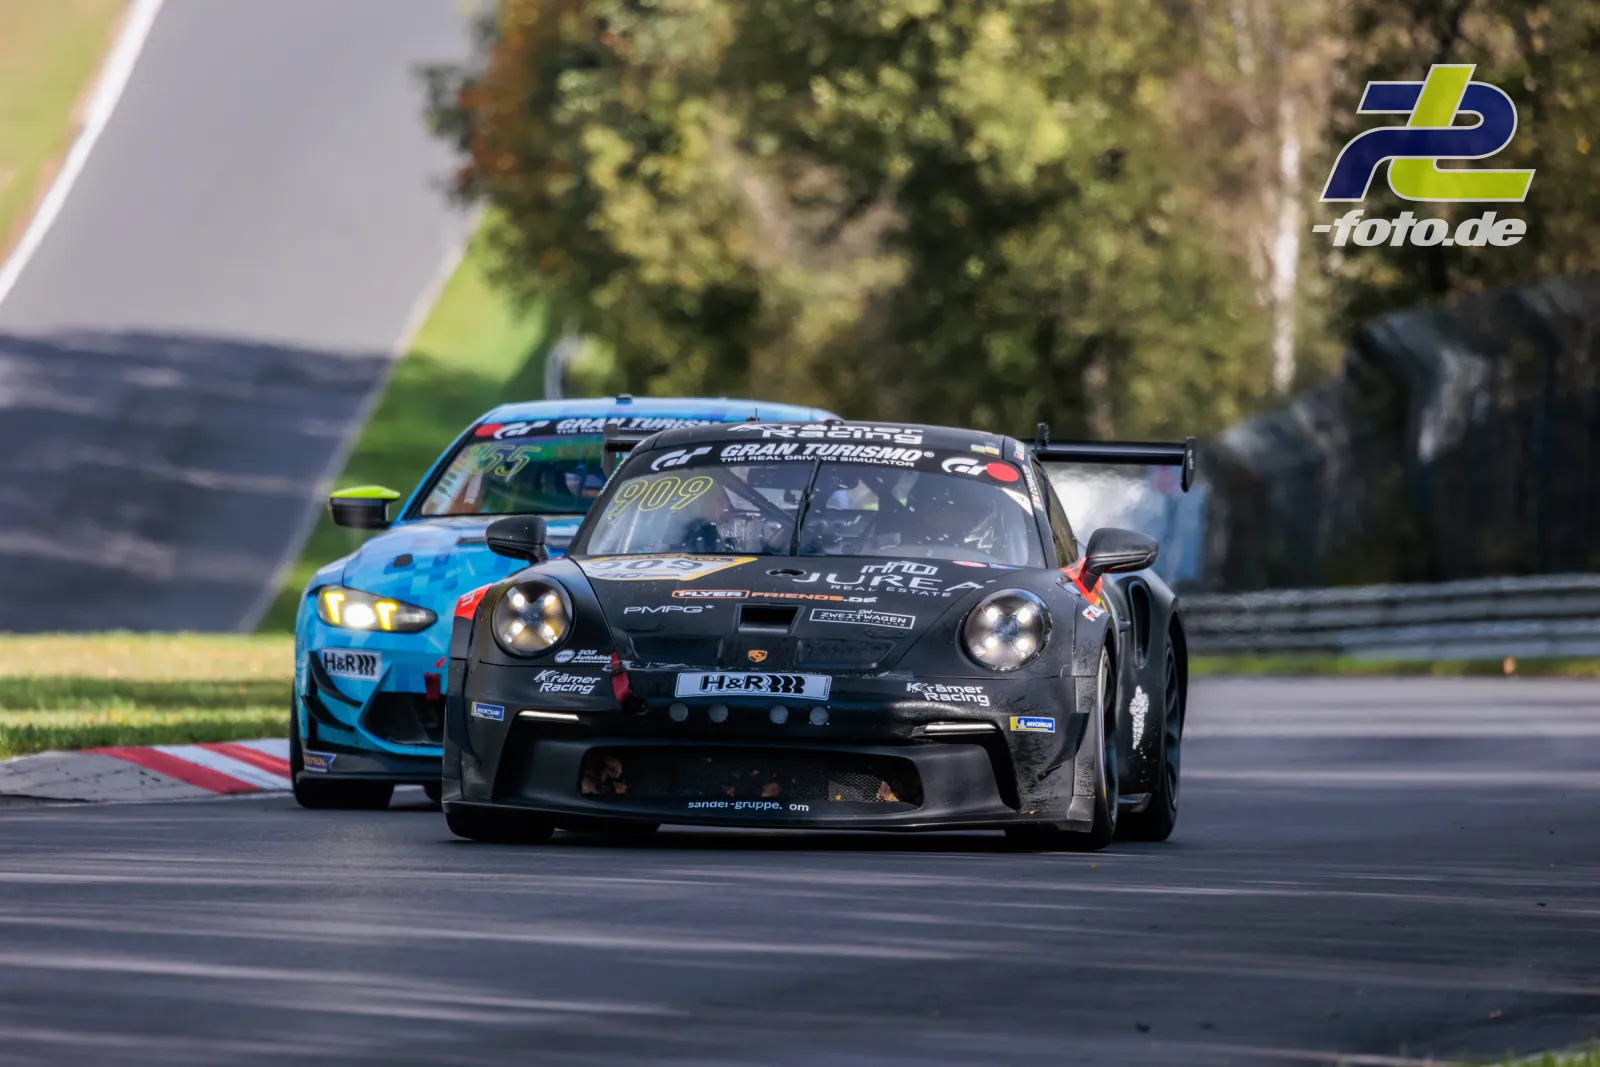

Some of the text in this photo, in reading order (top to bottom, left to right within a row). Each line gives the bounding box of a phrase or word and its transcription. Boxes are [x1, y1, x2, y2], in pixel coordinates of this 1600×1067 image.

[556, 417, 712, 430] GRAN TURIS
[761, 430, 923, 445] Racing
[720, 442, 799, 457] GRAN
[839, 456, 915, 467] SIMULATOR
[607, 475, 714, 517] 909
[791, 572, 985, 592] JUREA
[830, 584, 953, 597] REAL ESTATE
[820, 611, 907, 624] ZWEITWAGEN
[324, 652, 356, 673] H&R
[534, 669, 602, 684] Krämer
[700, 675, 766, 692] H&R
[539, 682, 596, 695] Racing
[906, 682, 984, 694] Krämer
[924, 692, 990, 707] Racing
